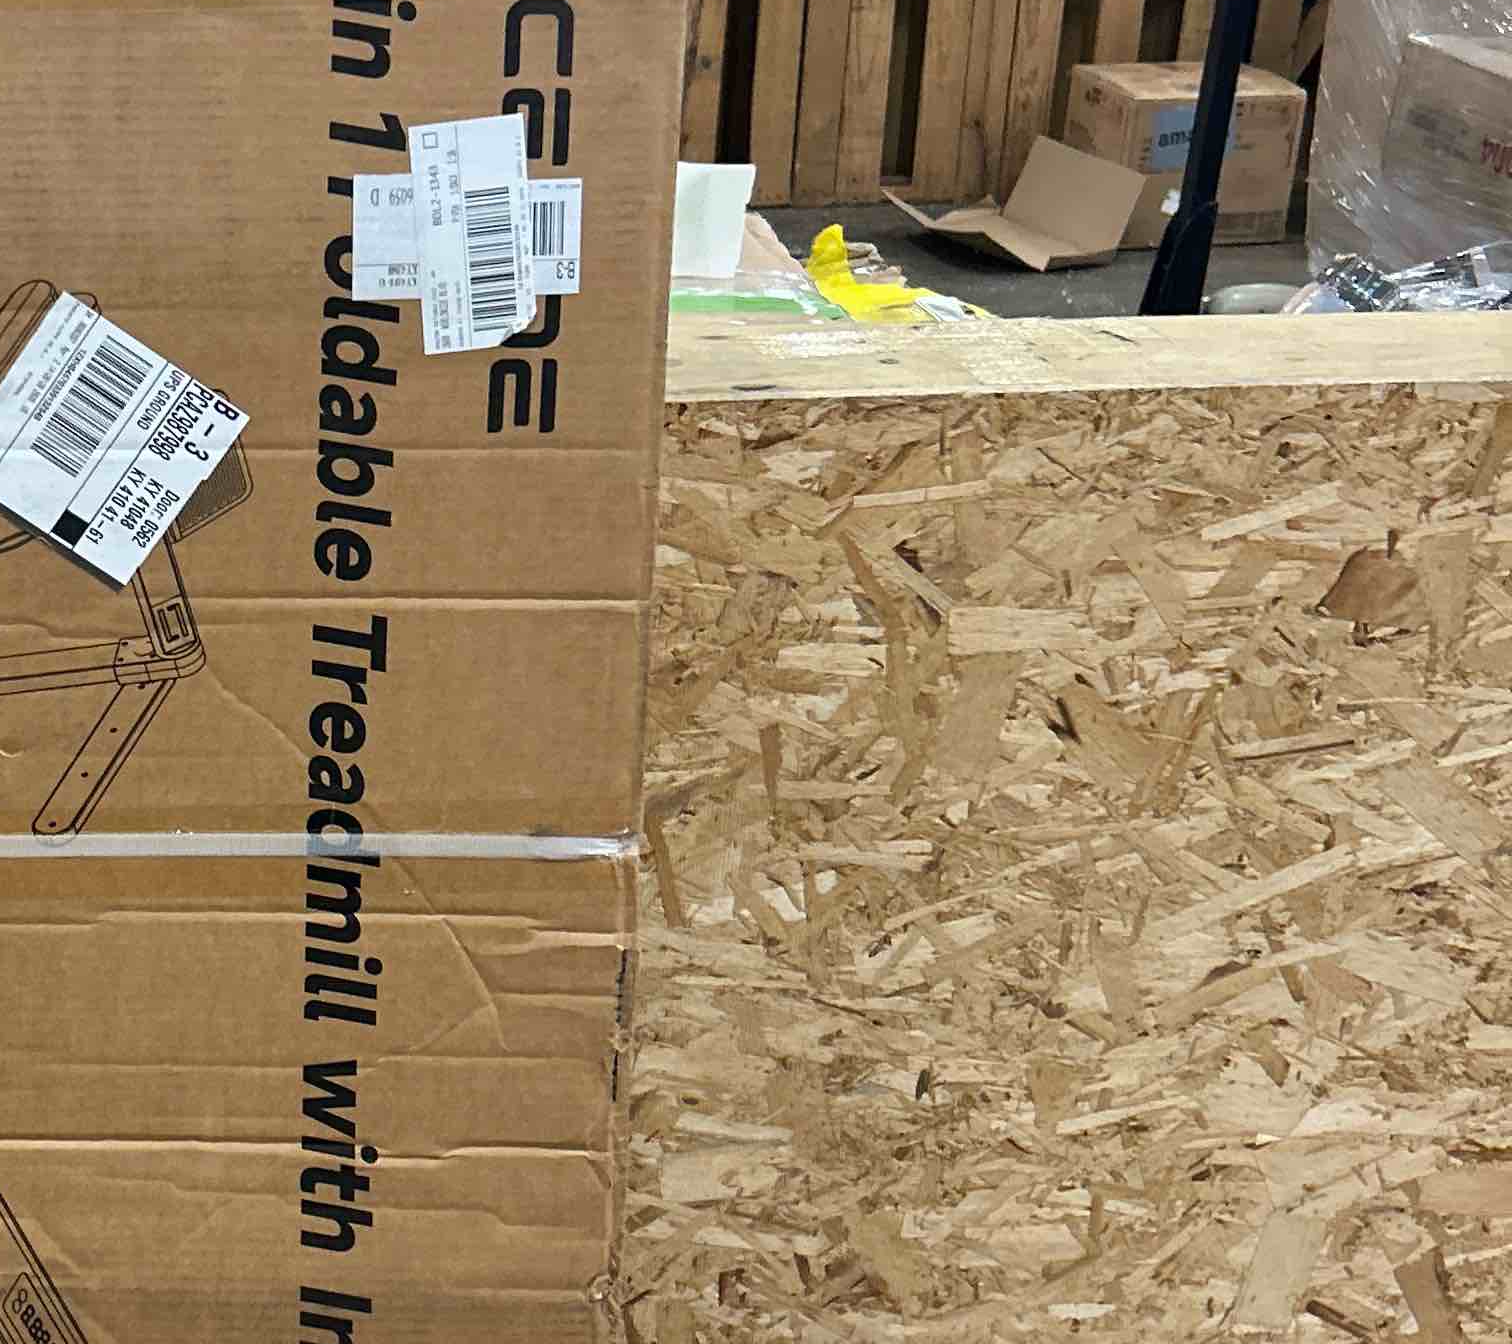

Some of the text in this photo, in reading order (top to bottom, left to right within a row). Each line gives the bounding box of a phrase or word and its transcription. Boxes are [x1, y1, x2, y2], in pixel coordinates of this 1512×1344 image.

[328, 112, 409, 153] 1
[137, 368, 186, 431] UPS GROUND
[214, 399, 240, 422] B
[184, 442, 210, 462] 3
[130, 466, 147, 488] KY
[146, 479, 164, 499] KY
[301, 614, 389, 1027] Treadmill
[296, 1058, 378, 1254] with
